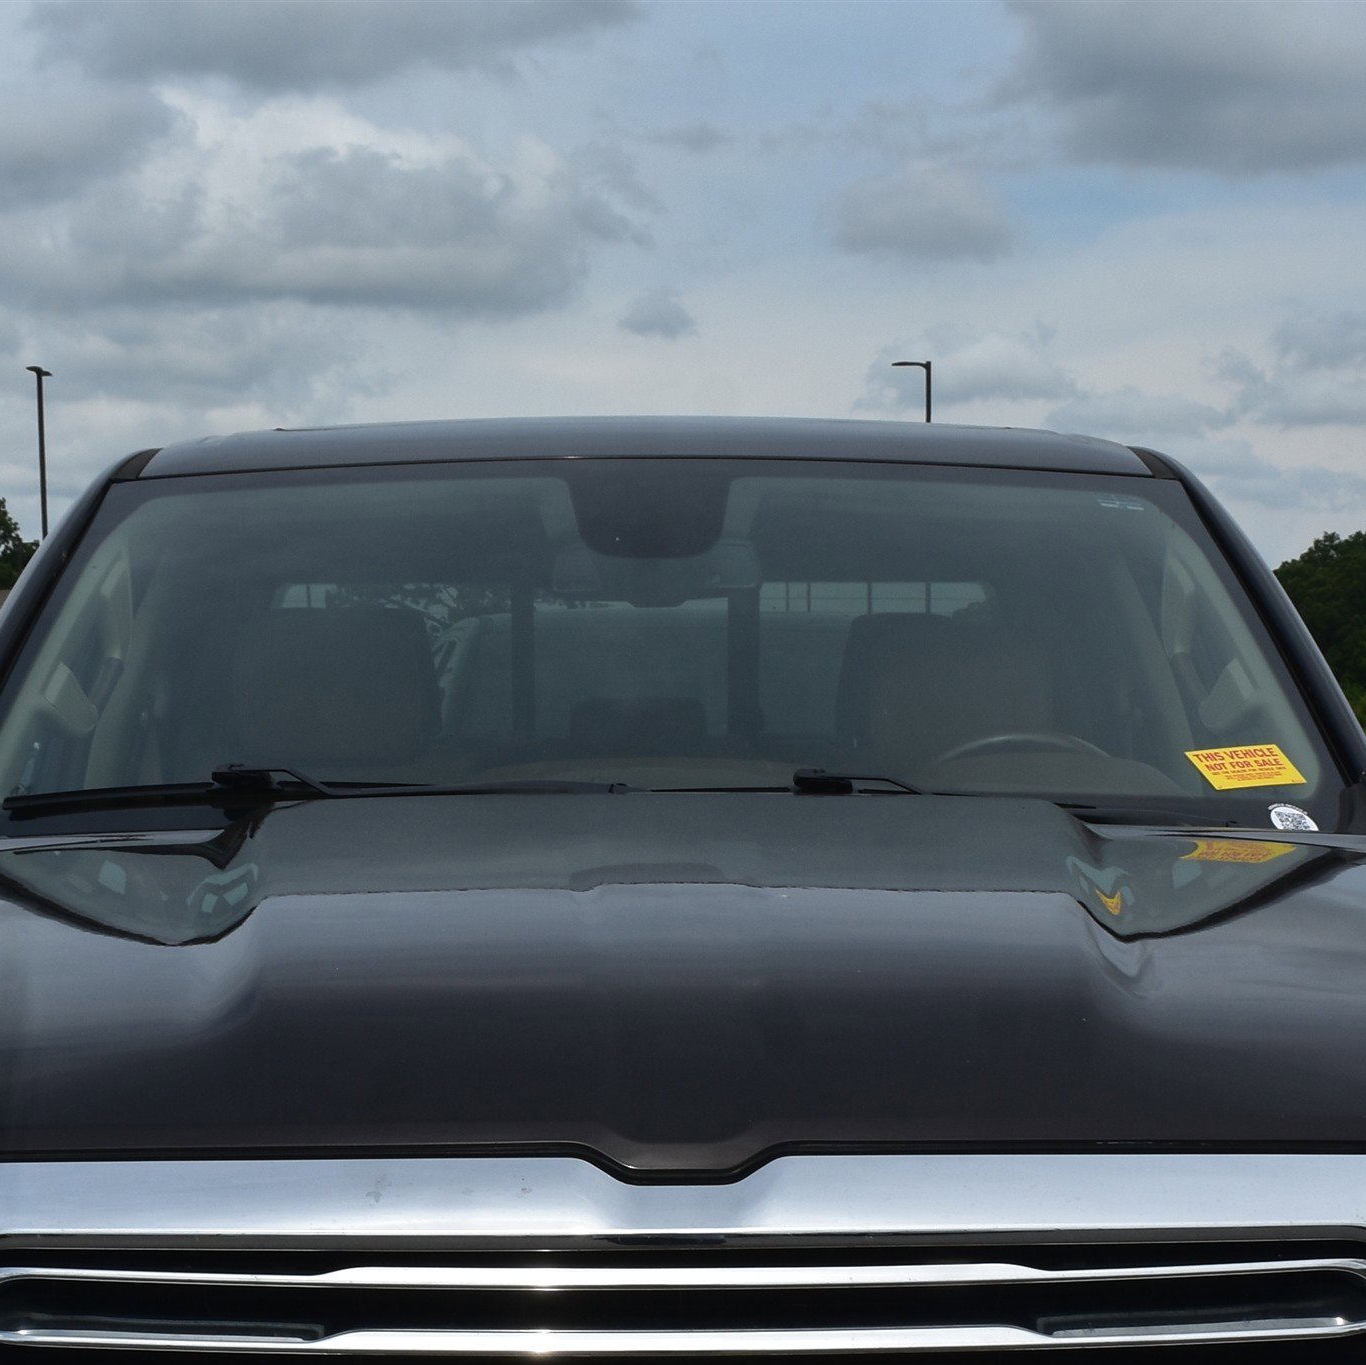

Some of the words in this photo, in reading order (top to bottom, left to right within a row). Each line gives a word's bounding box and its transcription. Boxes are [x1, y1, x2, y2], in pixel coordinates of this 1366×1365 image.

[1193, 751, 1225, 763] THIS
[1224, 747, 1278, 760] VEHICLE
[1205, 762, 1228, 772] NOT
[1230, 761, 1253, 769] FOR
[1254, 758, 1284, 768] SALE
